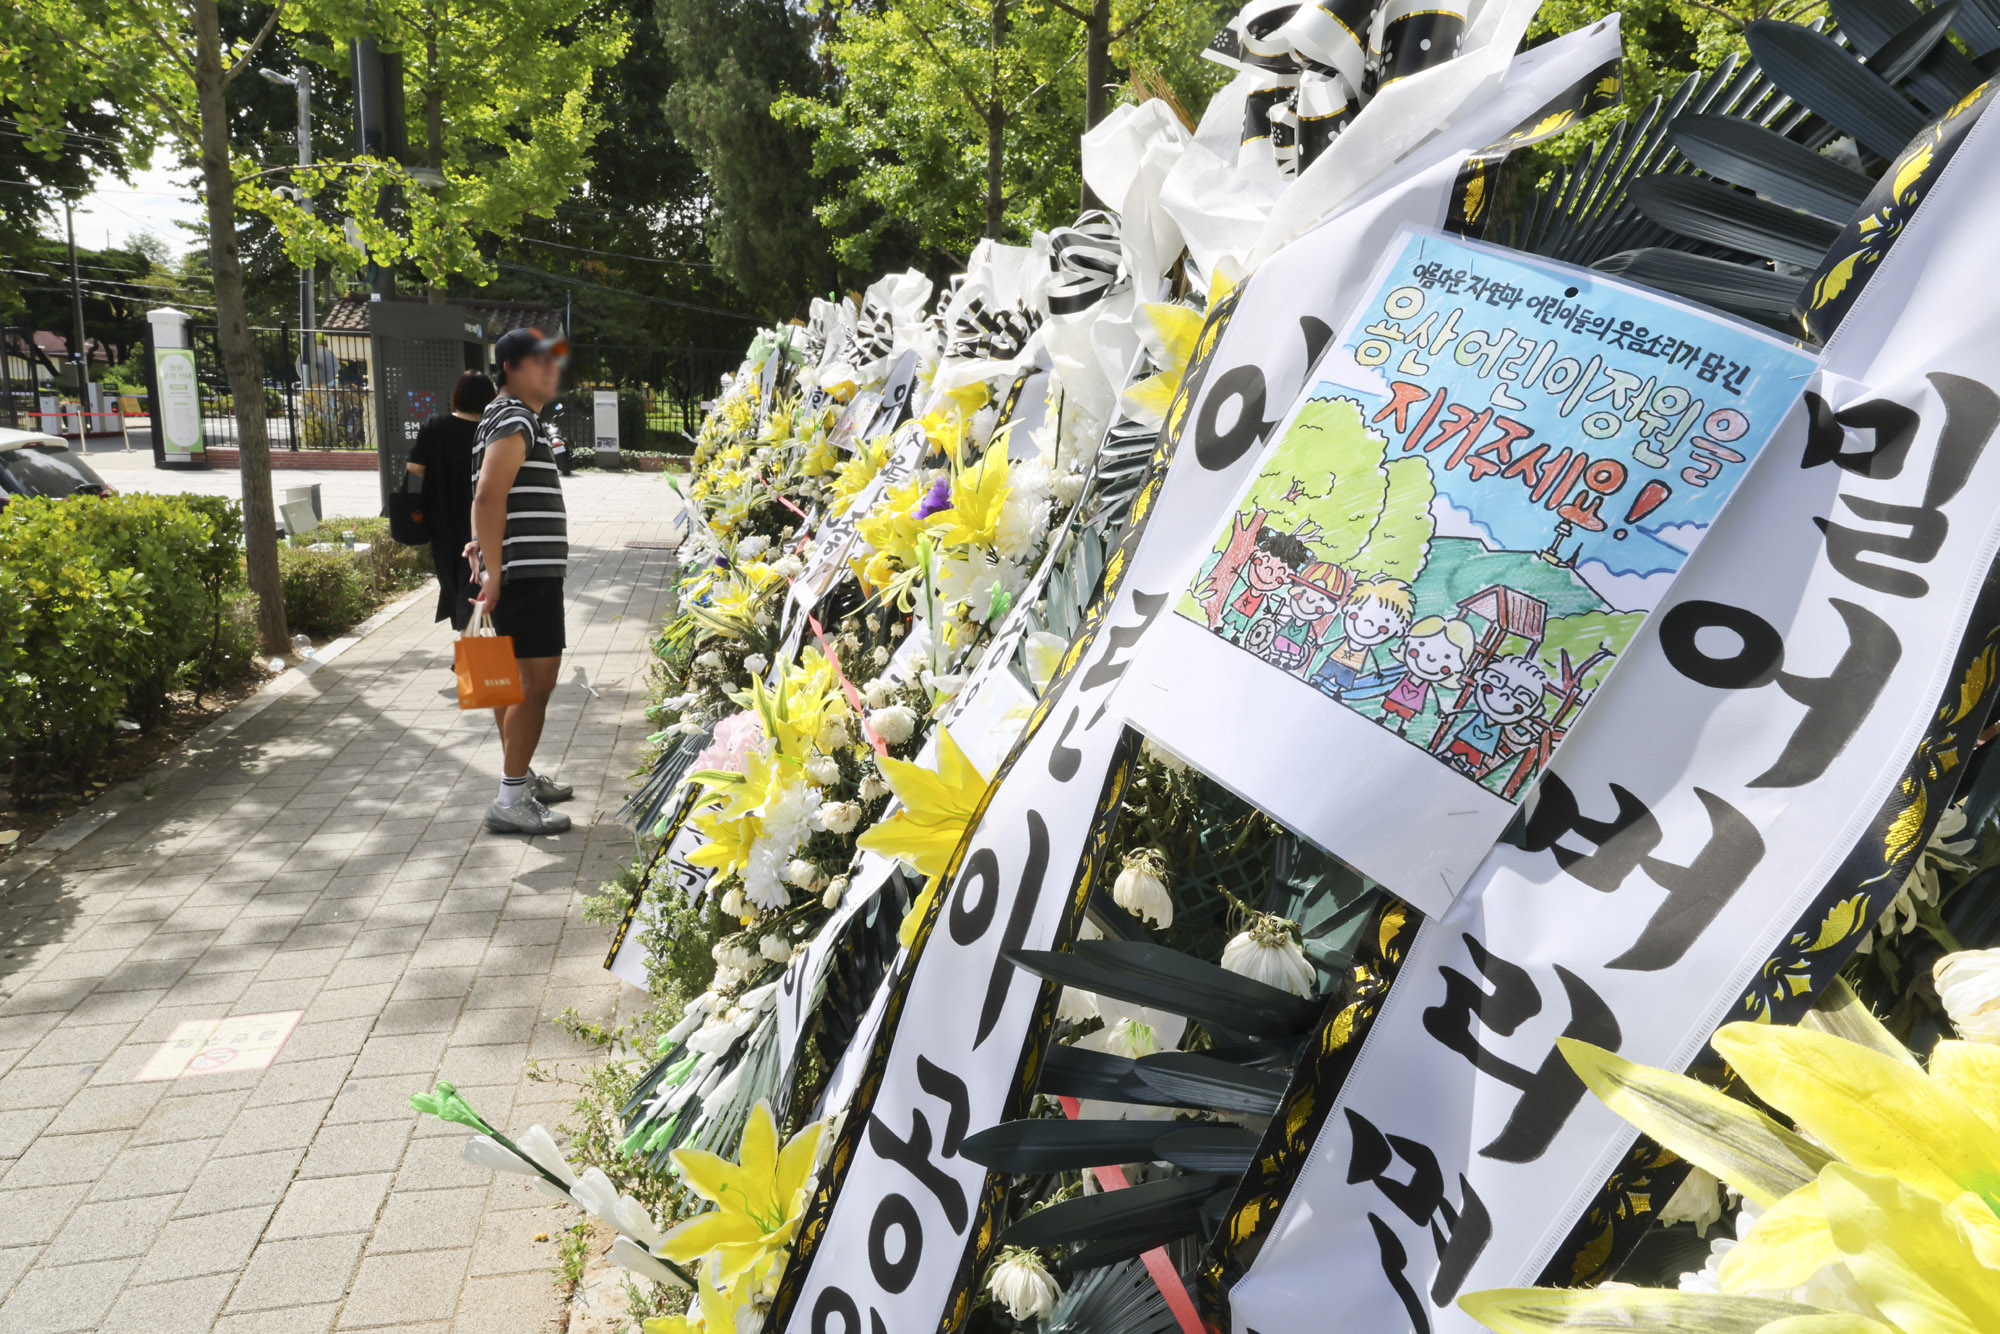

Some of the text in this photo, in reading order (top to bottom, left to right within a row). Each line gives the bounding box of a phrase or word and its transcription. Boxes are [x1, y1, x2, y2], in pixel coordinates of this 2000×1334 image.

[1413, 261, 1752, 396] 아름다운 자연과 어린이들의 웃음소리가 담긴
